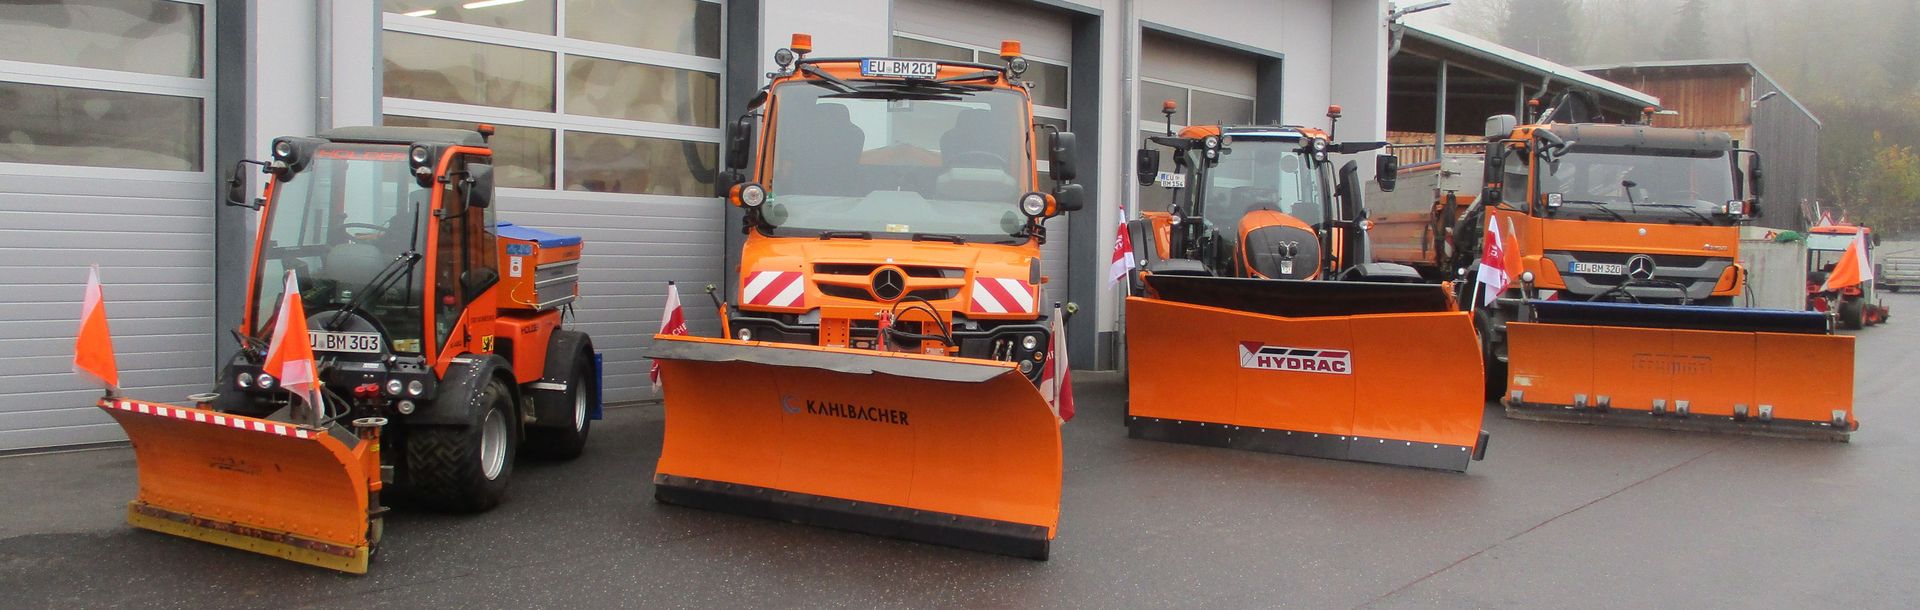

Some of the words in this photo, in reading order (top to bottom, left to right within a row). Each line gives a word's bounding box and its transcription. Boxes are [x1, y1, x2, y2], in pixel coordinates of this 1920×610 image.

[869, 61, 885, 73] EU
[893, 62, 909, 74] BM
[912, 63, 934, 75] 201
[1575, 263, 1587, 272] EU
[1591, 264, 1604, 273] BM
[1605, 265, 1621, 274] 320
[327, 335, 346, 350] BM
[350, 335, 379, 351] 303
[1257, 356, 1346, 373] HYDRAC
[806, 399, 910, 426] KAHLBACHER
